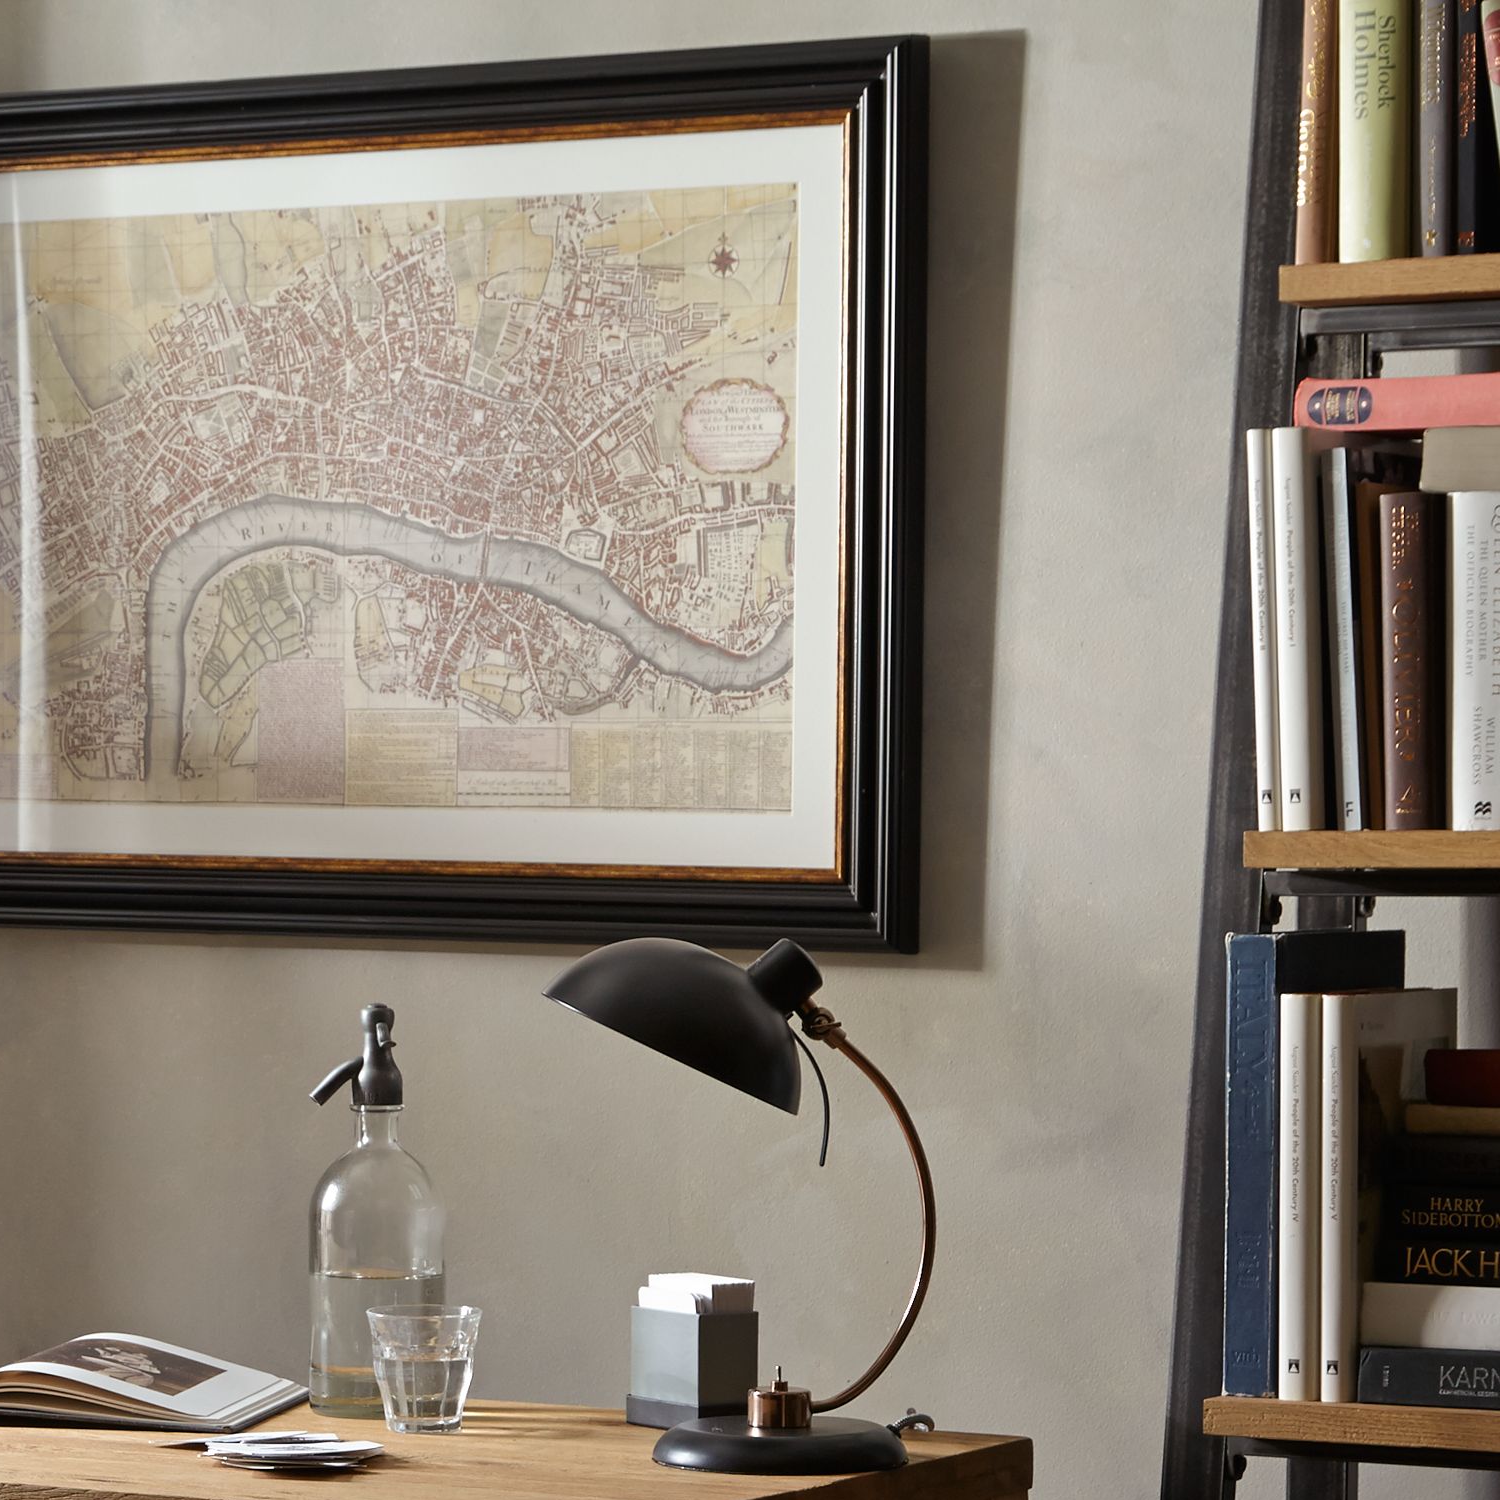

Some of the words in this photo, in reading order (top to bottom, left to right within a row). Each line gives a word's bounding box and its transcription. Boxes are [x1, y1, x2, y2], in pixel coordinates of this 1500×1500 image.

[1355, 8, 1376, 120] Holmes
[1379, 15, 1396, 109] Sherlock
[702, 423, 764, 433] SOUTHWARK
[1255, 531, 1263, 560] People
[1285, 530, 1293, 558] People
[1467, 524, 1475, 545] THE
[1480, 540, 1488, 561] THE
[1257, 572, 1265, 586] the
[1466, 551, 1475, 604] OFFICIAL
[1478, 566, 1488, 606] QUEEN
[1288, 588, 1296, 607] 20th
[1258, 610, 1266, 645] Century
[1288, 608, 1296, 643] Century
[1479, 610, 1488, 661] MOTHER
[1465, 609, 1474, 677] BIOGRAPHY
[1392, 598, 1421, 749] OLIVIER
[1472, 705, 1483, 786] SHAWCROSS
[1485, 716, 1496, 775] WILLIAM
[1291, 1098, 1300, 1127] People
[1330, 1098, 1338, 1127] People
[1292, 1140, 1300, 1154] the
[1331, 1141, 1339, 1154] the
[1292, 1157, 1300, 1176] 20th
[1331, 1157, 1339, 1176] 20th
[1291, 1178, 1300, 1214] Century
[1329, 1179, 1338, 1214] Century
[1430, 1197, 1484, 1212] HARRY
[1292, 1215, 1300, 1223] IV
[1330, 1214, 1338, 1222] V
[1405, 1247, 1476, 1278] JACK
